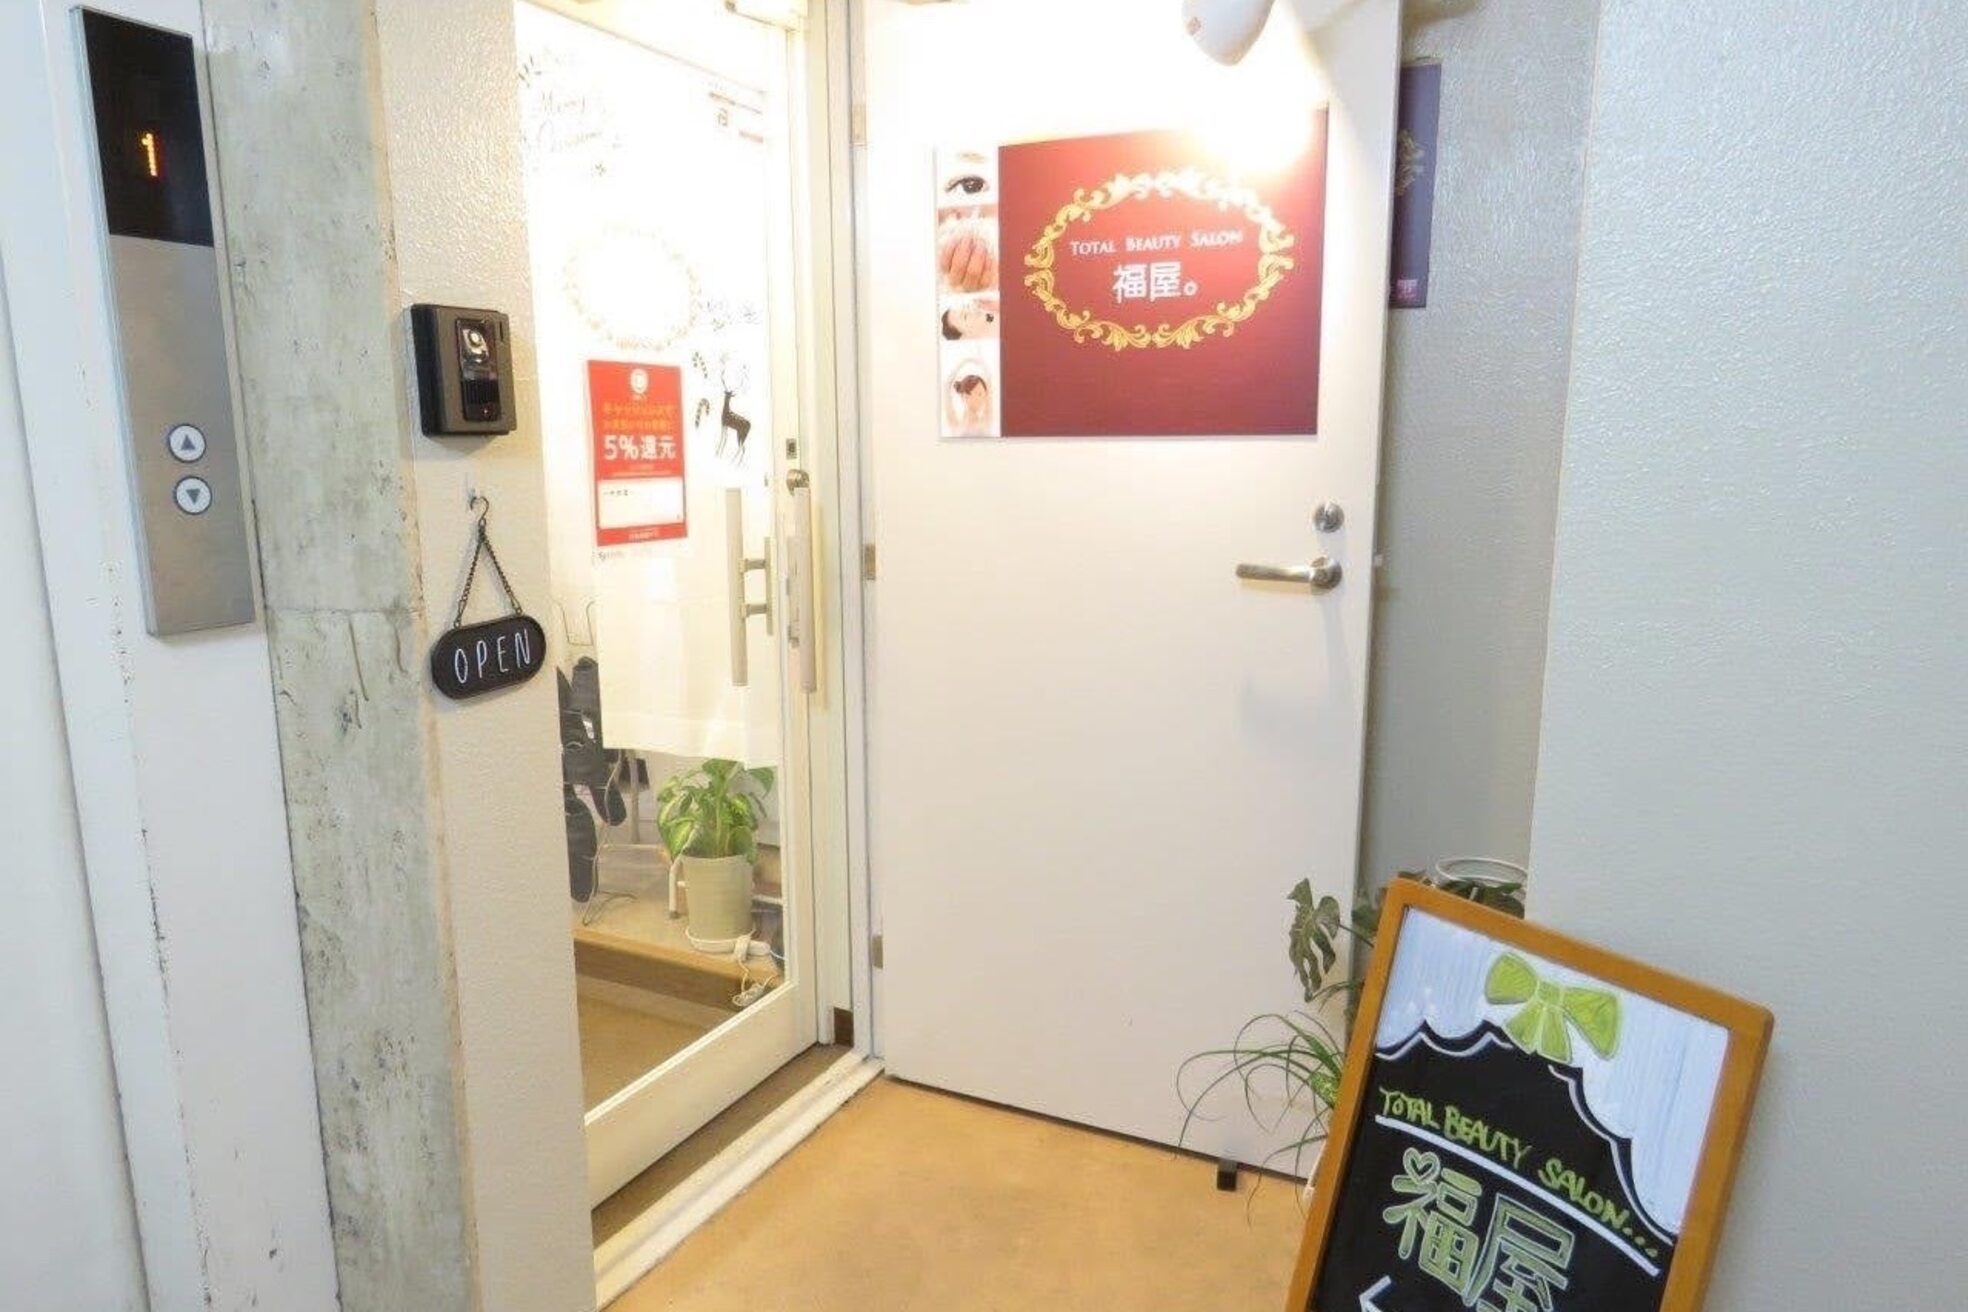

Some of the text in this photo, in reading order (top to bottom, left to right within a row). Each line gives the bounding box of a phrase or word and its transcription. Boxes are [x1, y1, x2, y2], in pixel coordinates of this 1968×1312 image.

[141, 132, 157, 176] 1
[1070, 229, 1242, 257] TOTAL BEAUTY SALON
[1111, 260, 1198, 304] 福屋。
[454, 628, 531, 684] OPEN
[1379, 1085, 1440, 1129] TOTAL
[1442, 1104, 1534, 1169] BEAUTY
